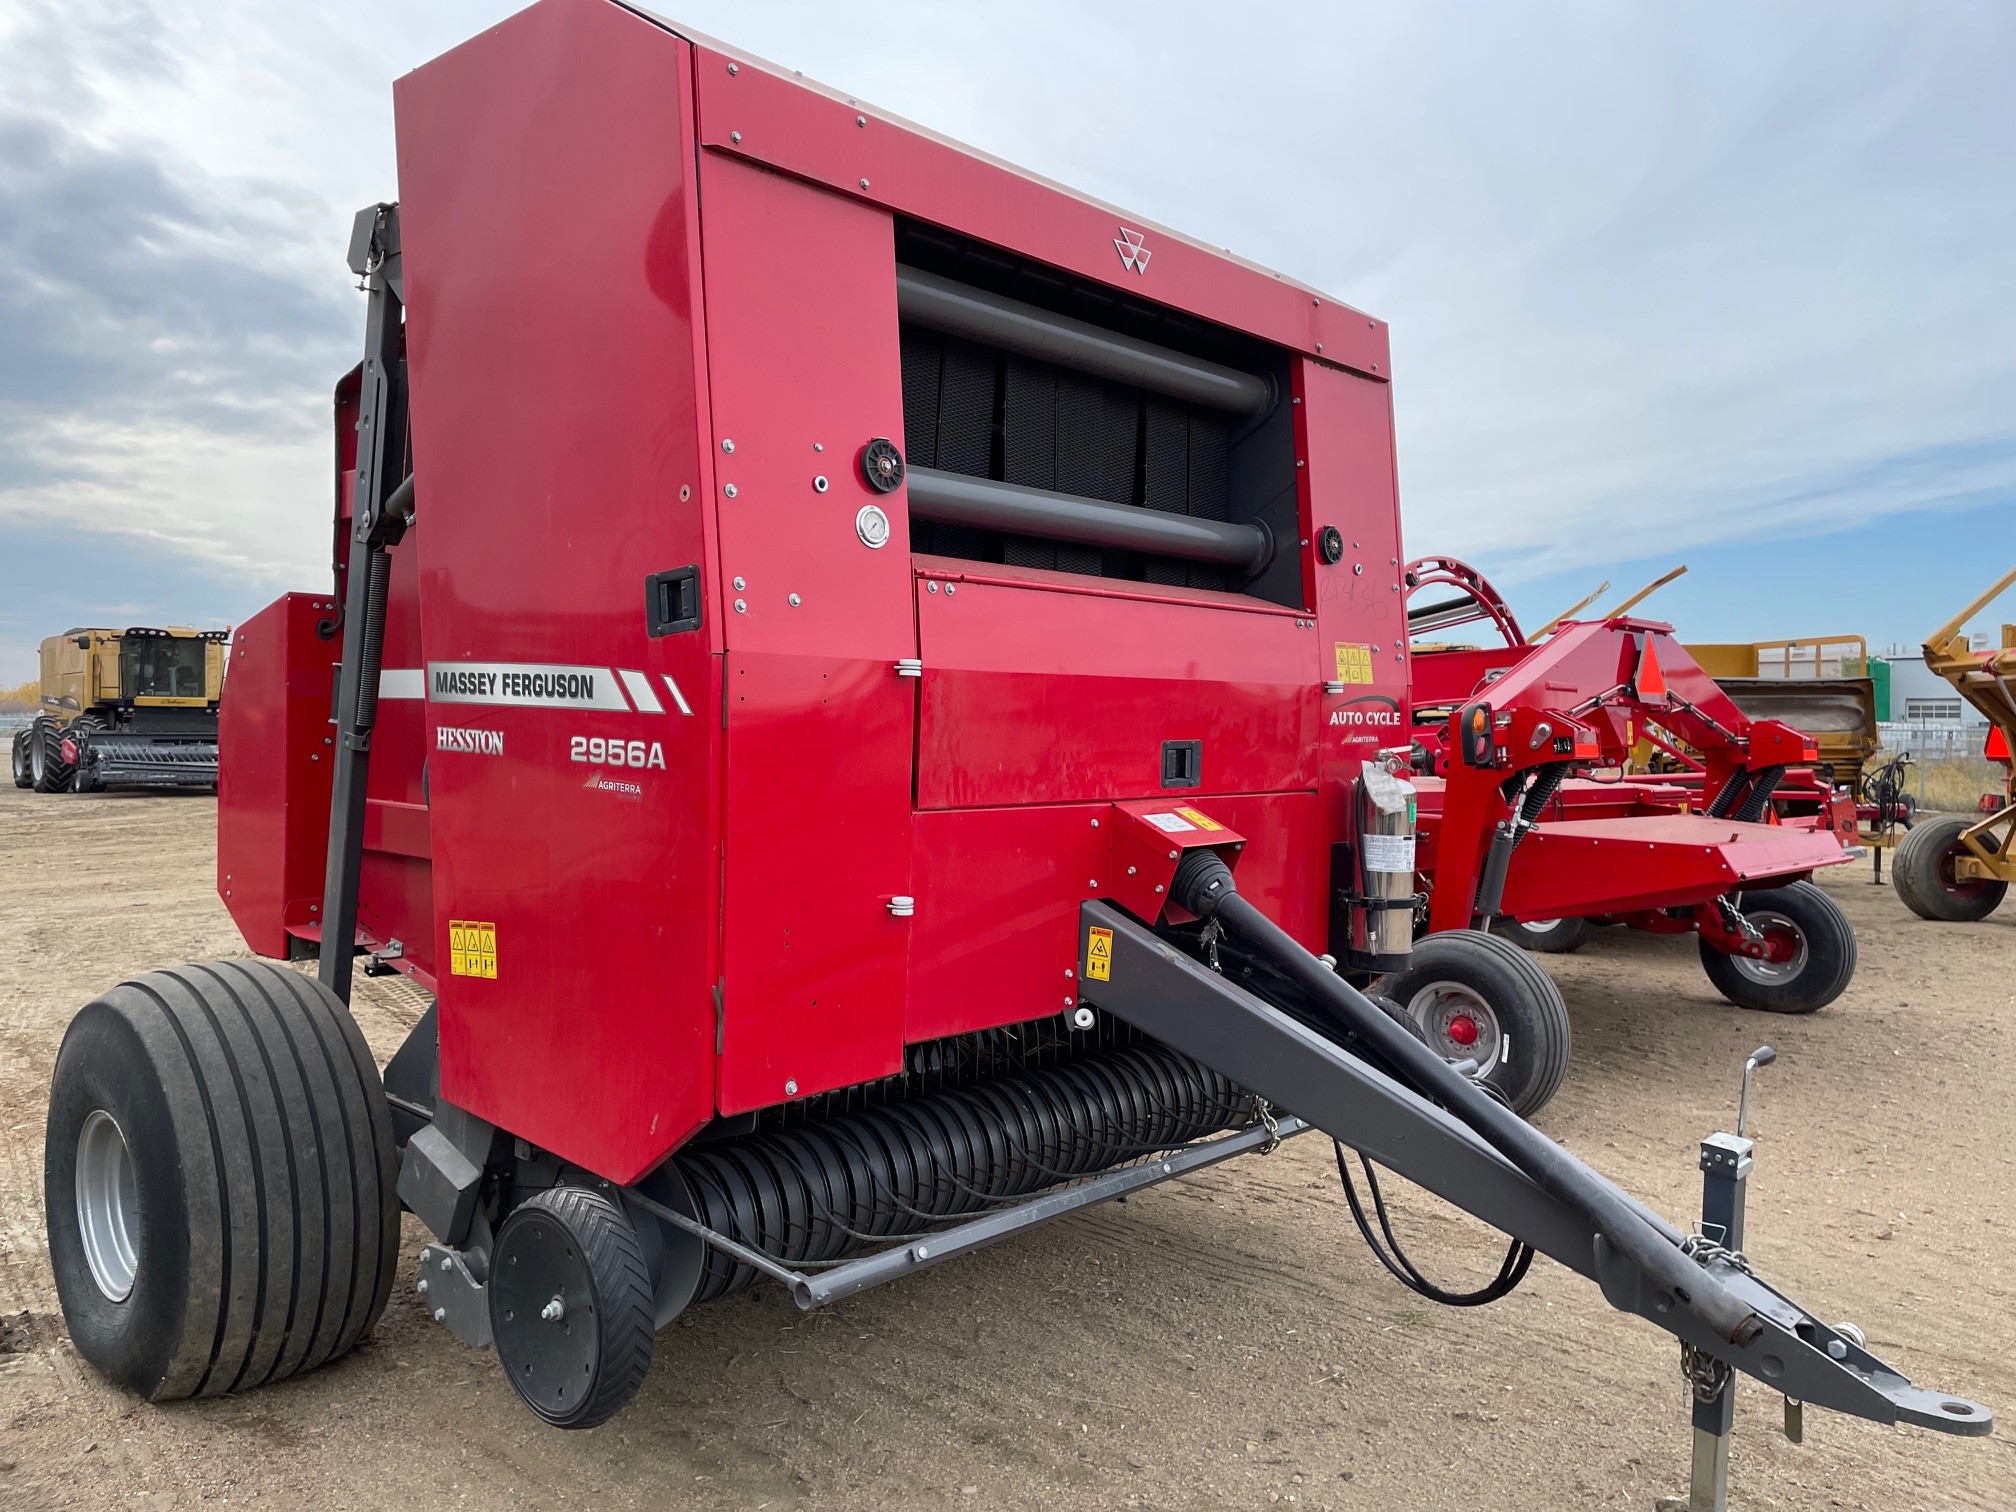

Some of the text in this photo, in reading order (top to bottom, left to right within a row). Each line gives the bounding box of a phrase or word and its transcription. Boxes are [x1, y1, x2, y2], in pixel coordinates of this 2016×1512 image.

[435, 671, 594, 700] MASSEY FERGUSON
[1329, 711, 1401, 726] AUTO CYCLE
[436, 726, 503, 756] HESSTON
[1351, 735, 1379, 744] AGRITERRA
[570, 736, 667, 771] 2956A
[598, 780, 641, 794] AGRITERRA
